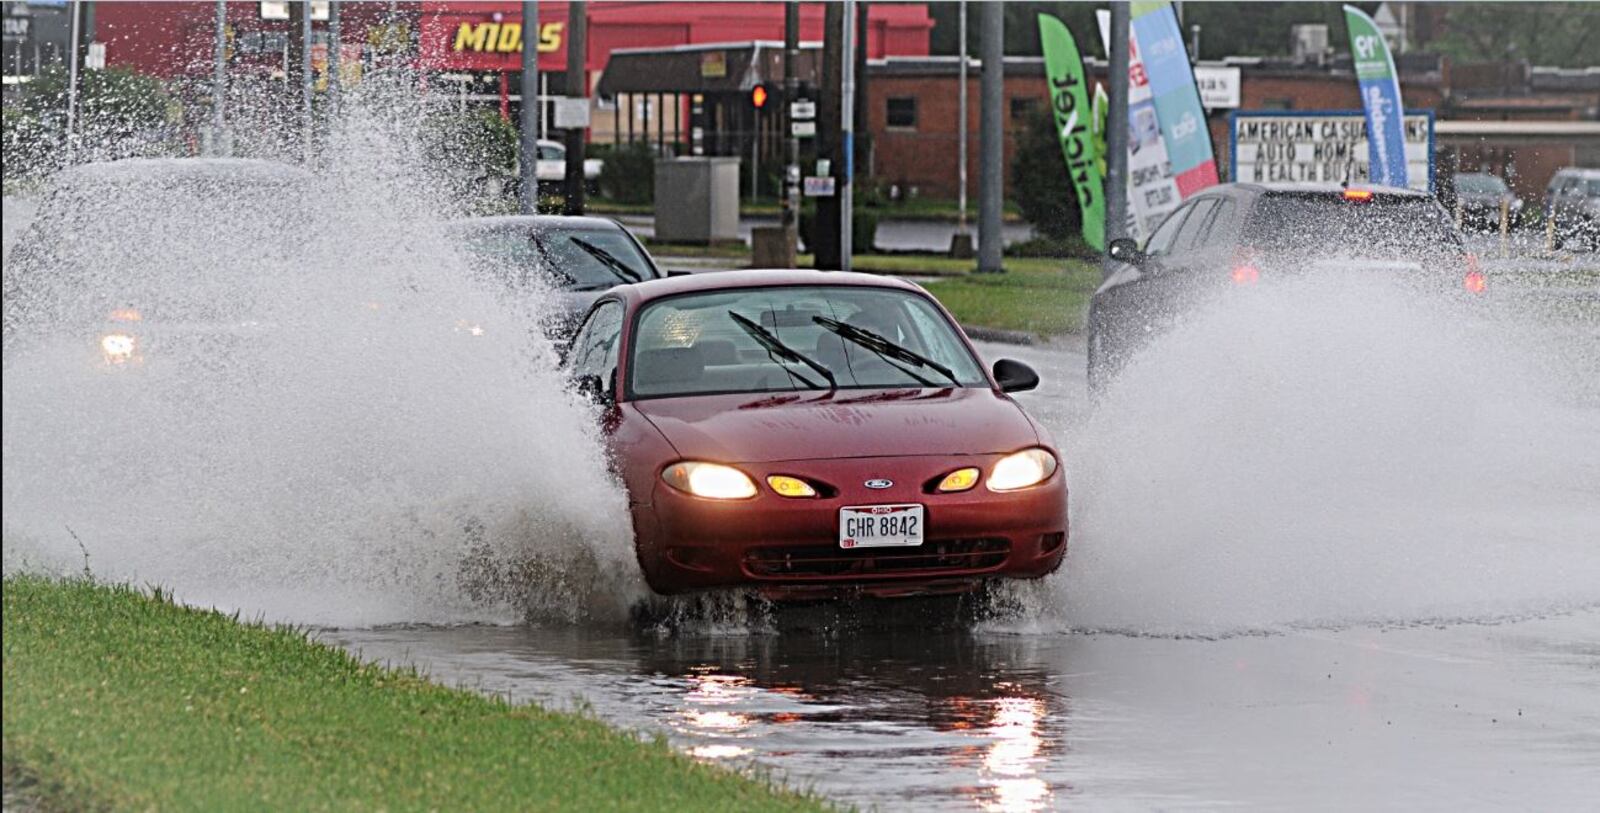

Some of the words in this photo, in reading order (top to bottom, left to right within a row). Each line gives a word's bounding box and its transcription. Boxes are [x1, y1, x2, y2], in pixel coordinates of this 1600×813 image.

[454, 22, 564, 52] MIDS
[1238, 121, 1313, 140] AMERICAN
[1321, 121, 1368, 140] CASUA
[1256, 142, 1296, 161] AUTO
[1314, 142, 1356, 161] HOME
[1254, 161, 1317, 182] HEALTH
[1323, 161, 1368, 182] BUSIN
[847, 518, 875, 538] GHR
[880, 516, 917, 536] 8842
